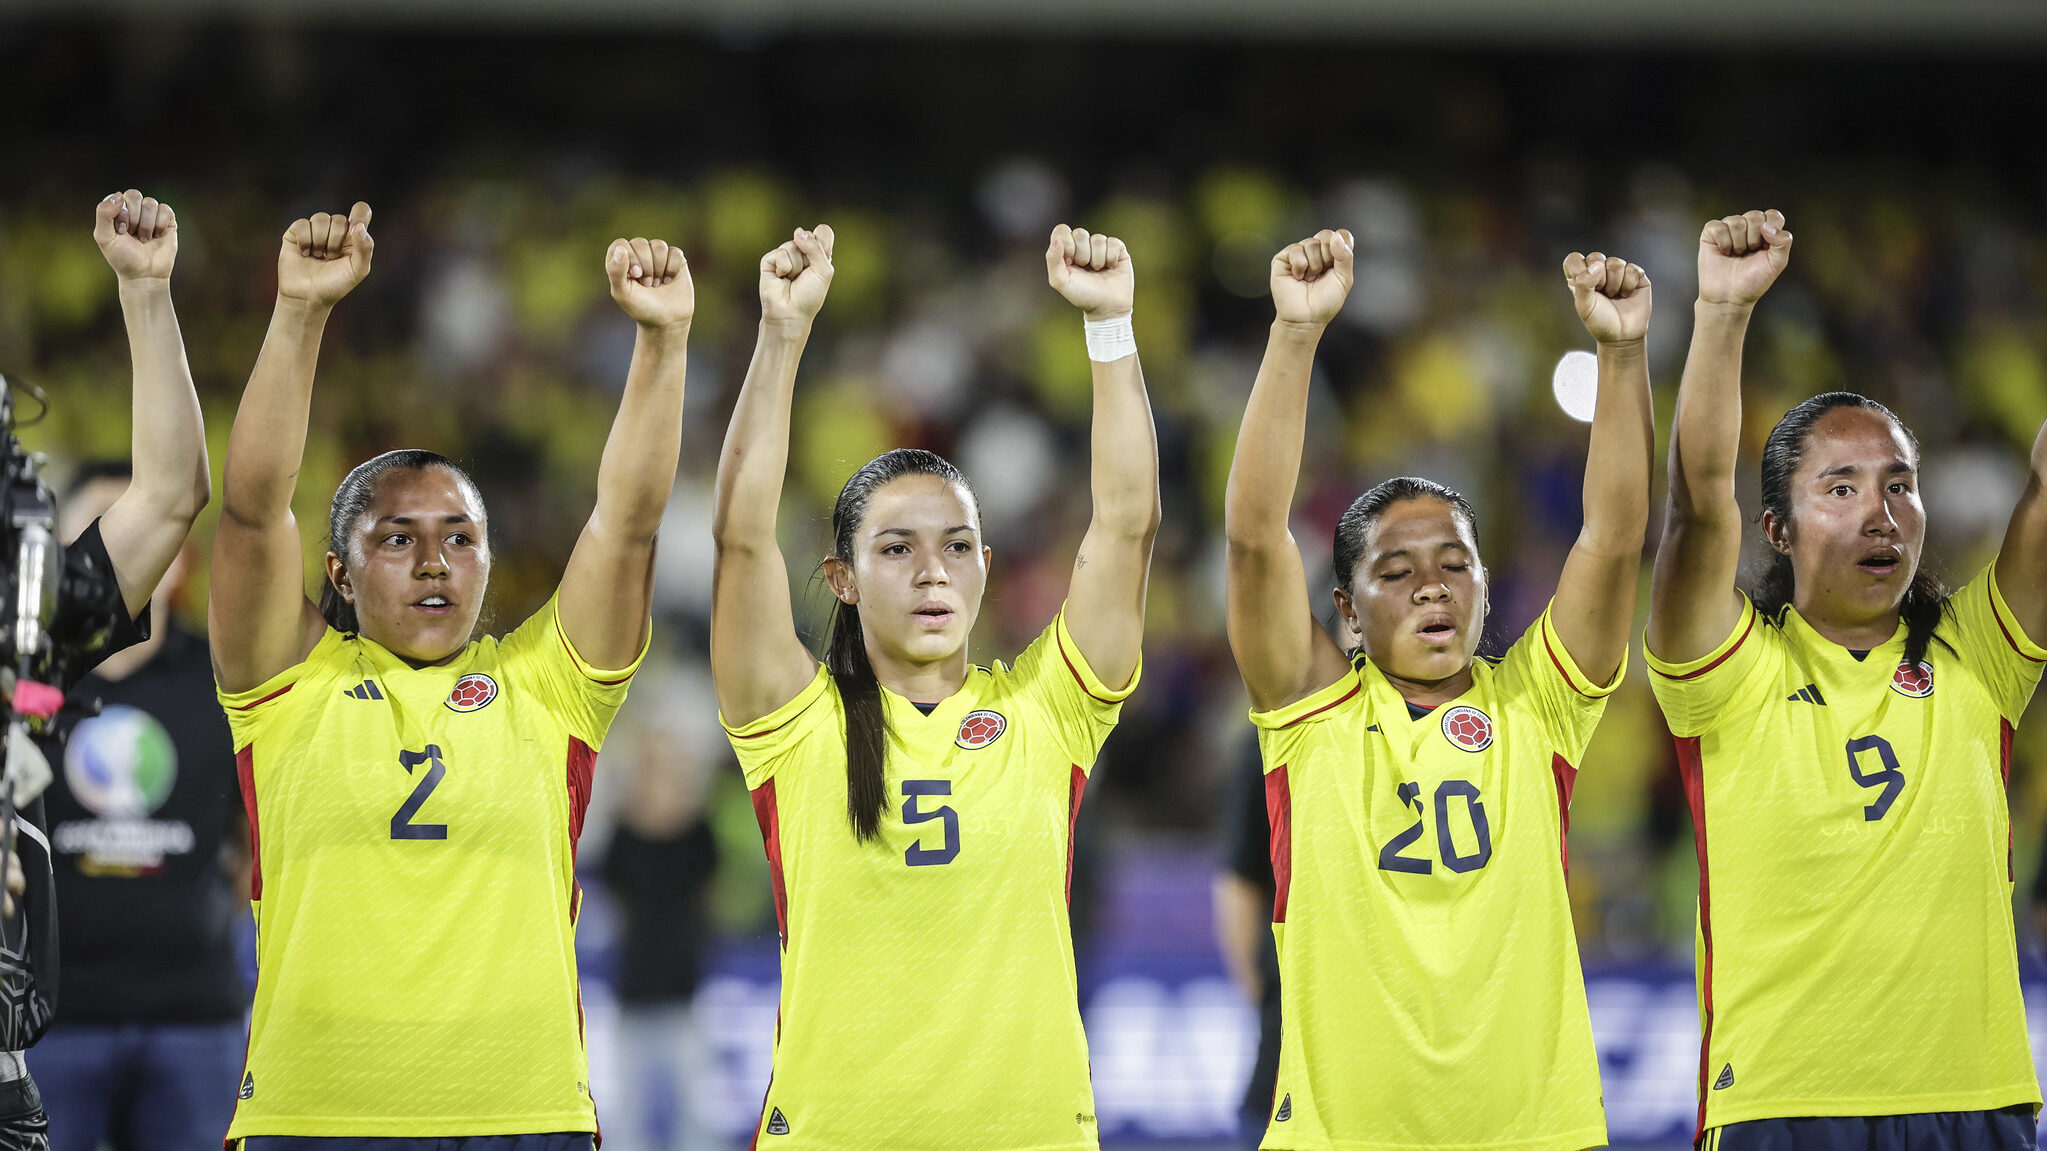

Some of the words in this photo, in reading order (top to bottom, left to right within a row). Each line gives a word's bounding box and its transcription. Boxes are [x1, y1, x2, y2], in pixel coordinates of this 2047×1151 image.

[390, 744, 448, 840] 2
[901, 780, 961, 867] 5
[1846, 734, 1906, 822] 9
[1379, 780, 1492, 875] 20
